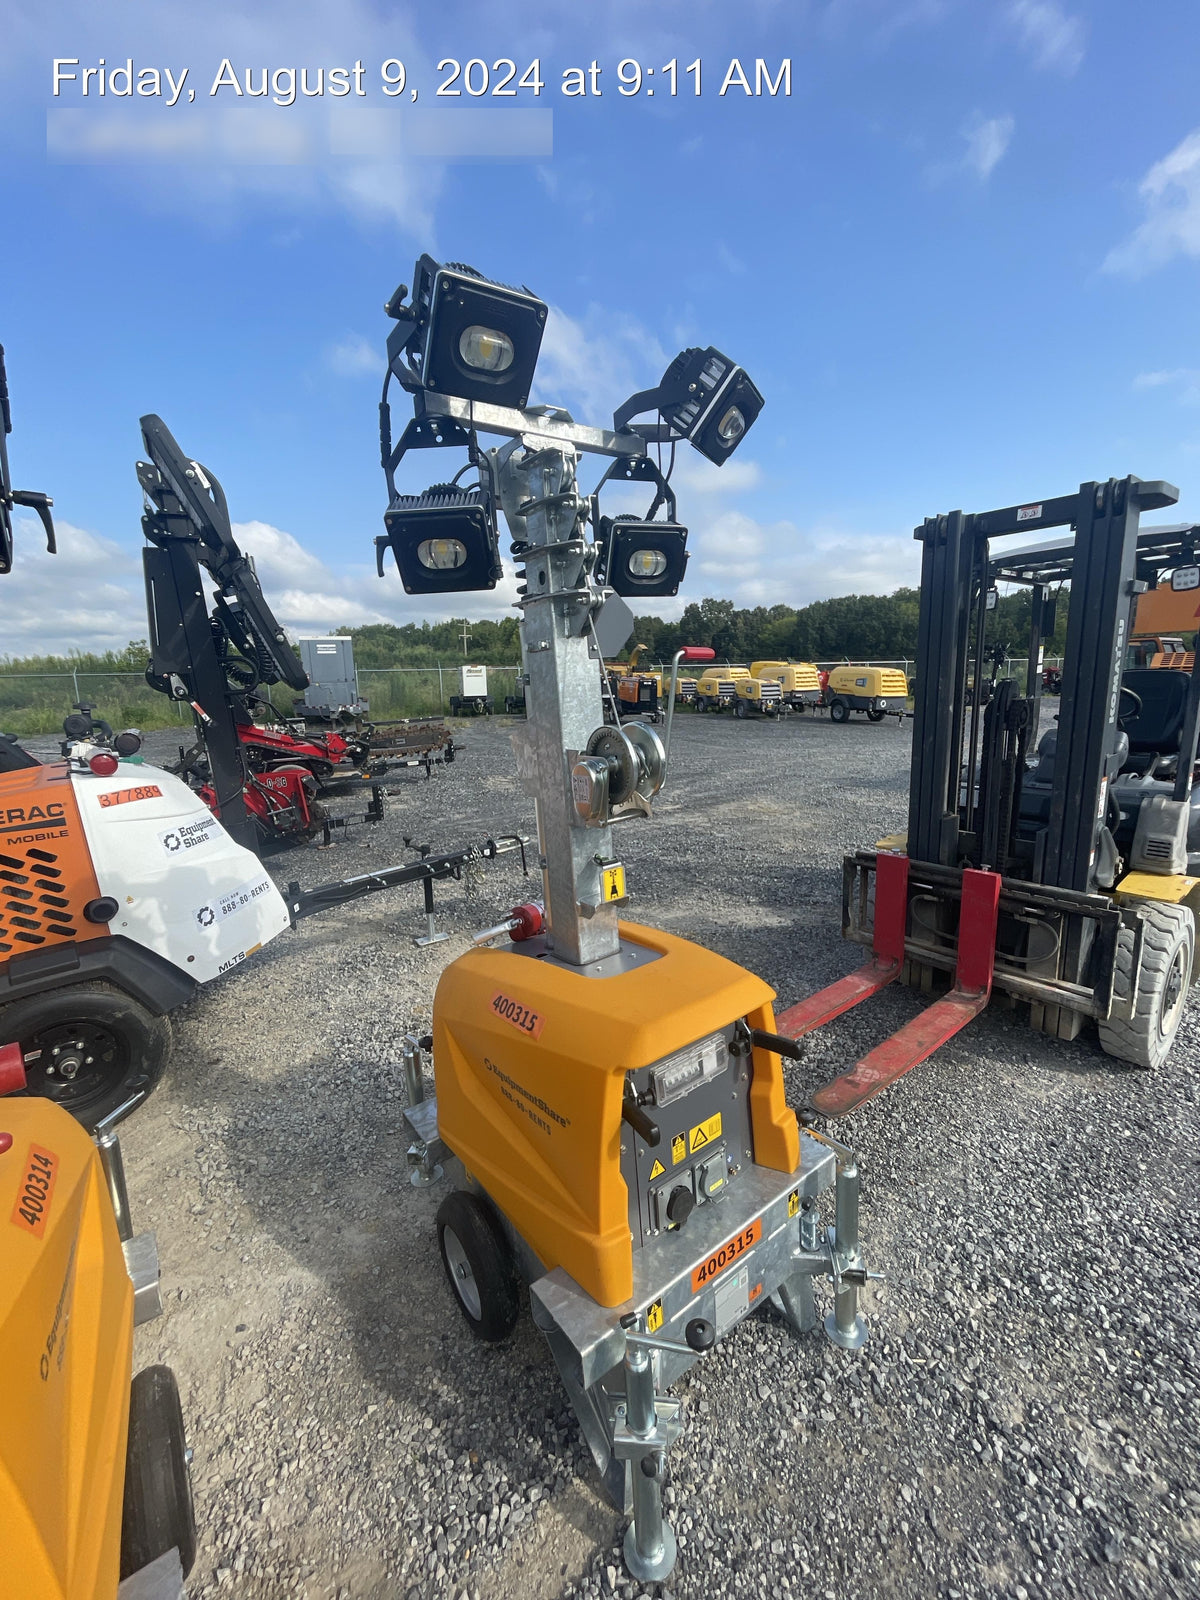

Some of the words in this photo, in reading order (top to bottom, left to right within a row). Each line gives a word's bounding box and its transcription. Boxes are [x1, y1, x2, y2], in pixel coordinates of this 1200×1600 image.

[1108, 619, 1125, 724] KOMATSU
[99, 785, 162, 807] 377889
[7, 830, 70, 845] MOBILE
[178, 817, 217, 838] Equipment
[184, 832, 211, 849] Share
[219, 896, 230, 905] CALL
[221, 881, 270, 915] 888-80-RENTS
[218, 951, 246, 974] MLTS
[492, 995, 539, 1032] 400315
[18, 1153, 54, 1227] 400314
[697, 1227, 754, 1282] 400315
